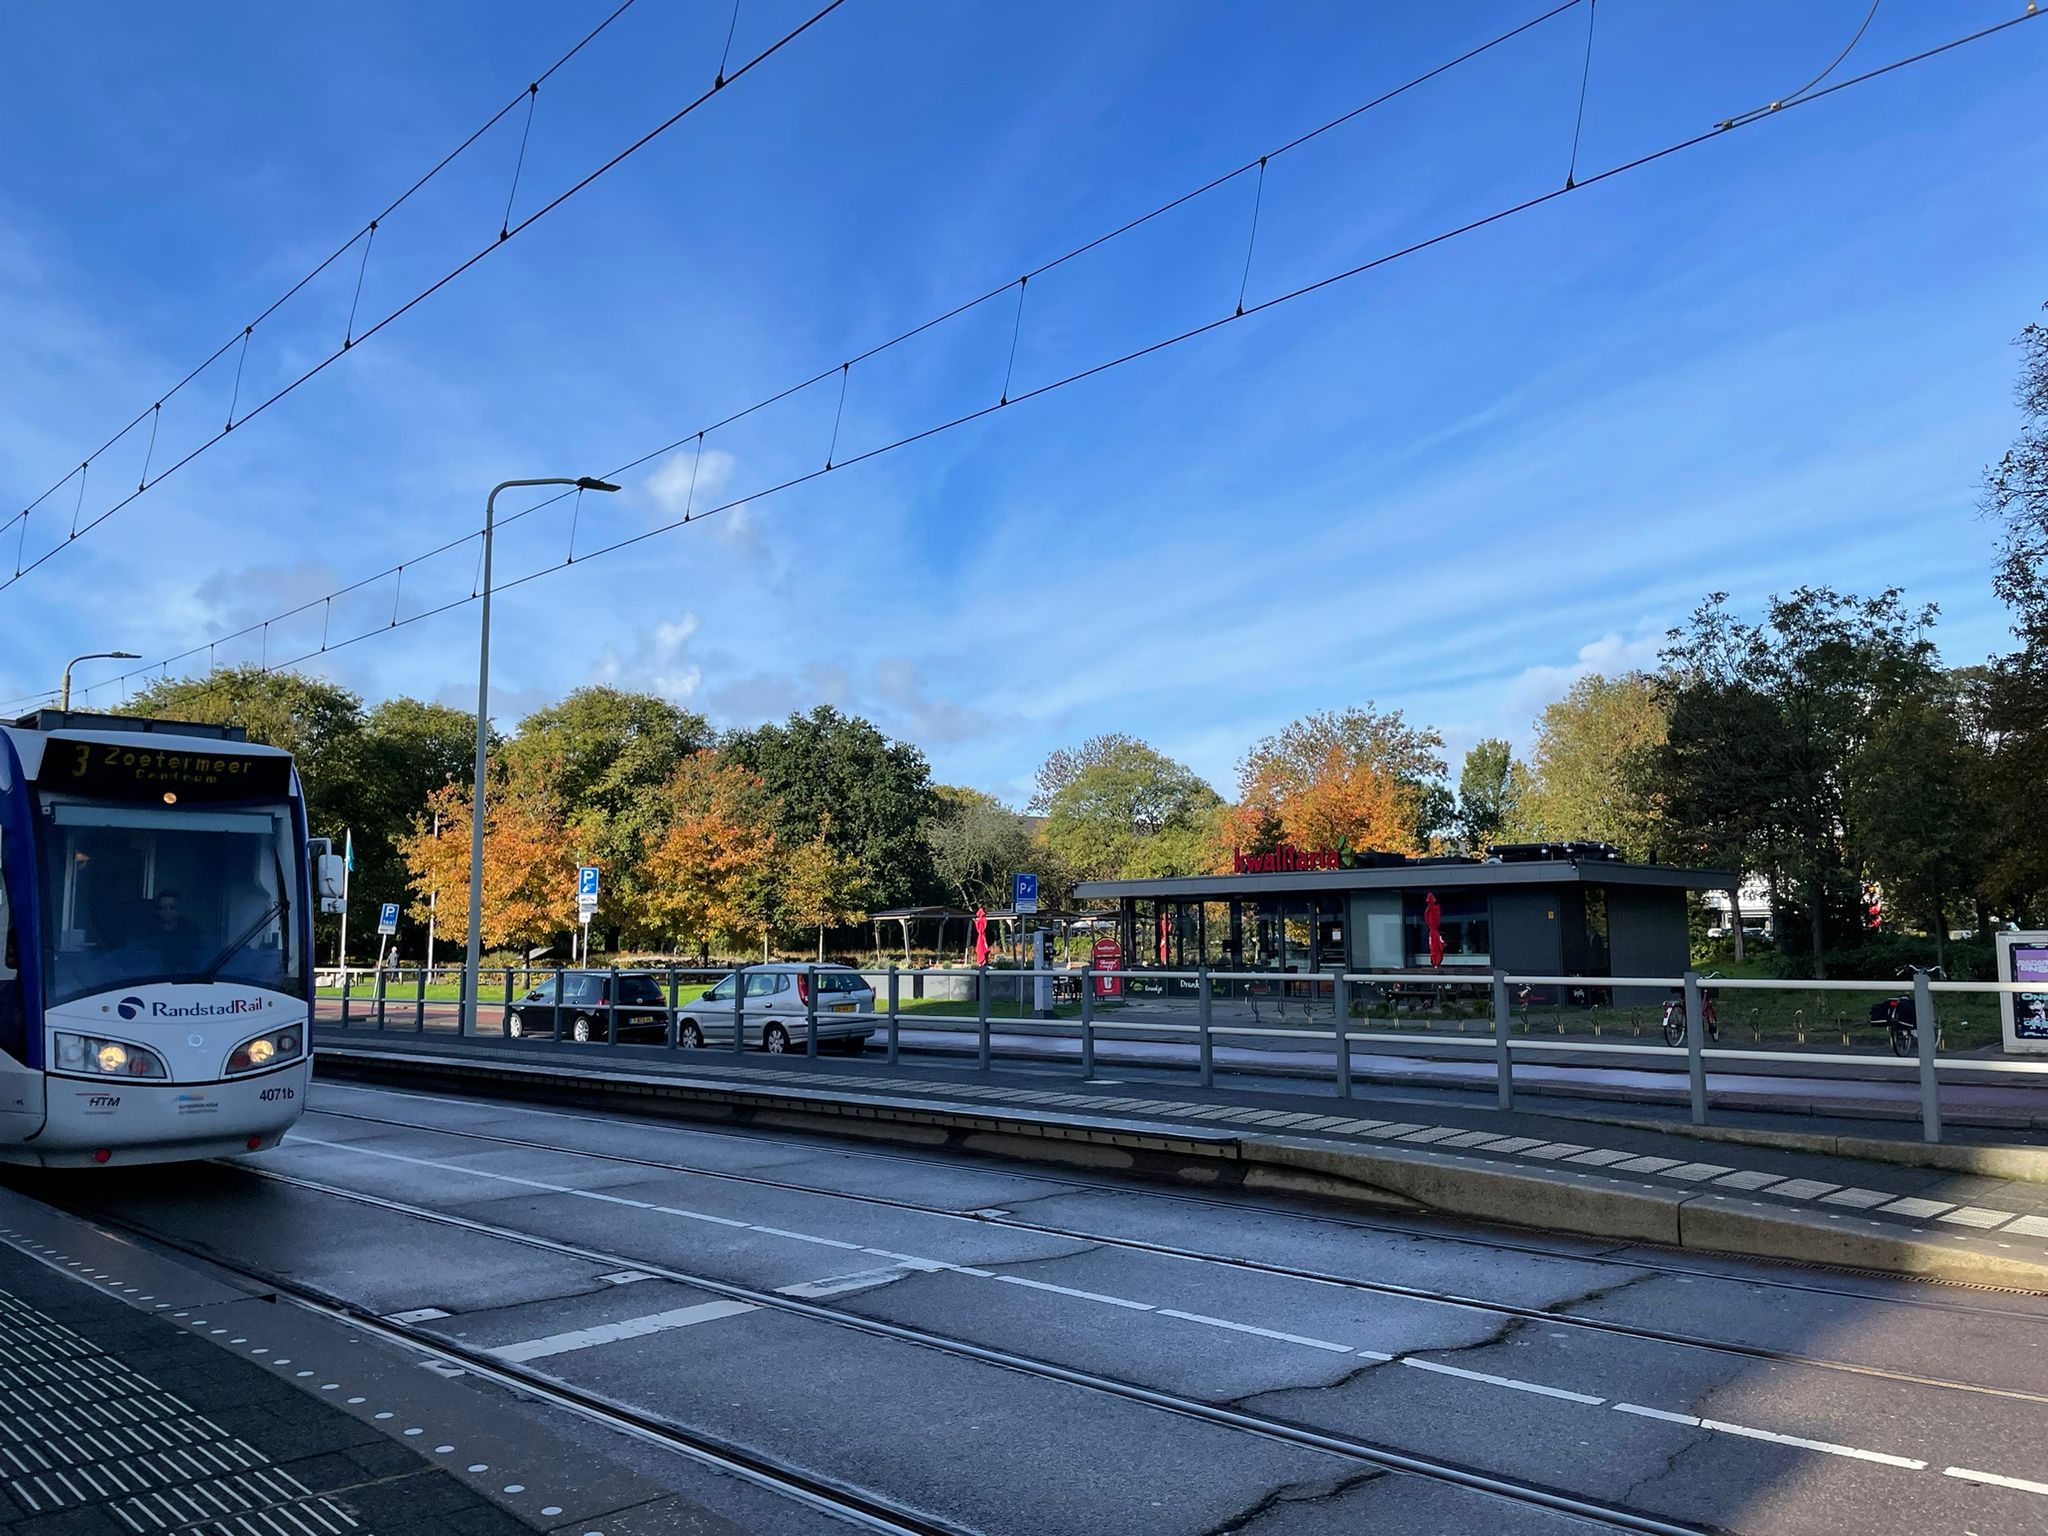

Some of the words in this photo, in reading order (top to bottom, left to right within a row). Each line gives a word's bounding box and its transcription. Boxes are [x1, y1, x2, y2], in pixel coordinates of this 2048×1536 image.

[71, 744, 90, 777] 3
[104, 746, 252, 774] Zoetermeer
[135, 769, 217, 784] Centrum
[1233, 843, 1340, 873] kwalitaria
[583, 870, 594, 884] P
[1020, 882, 1027, 895] P
[385, 906, 395, 917] P
[152, 997, 263, 1017] RandstadRail
[89, 1097, 121, 1107] HTM
[259, 1087, 295, 1102] 4071b
